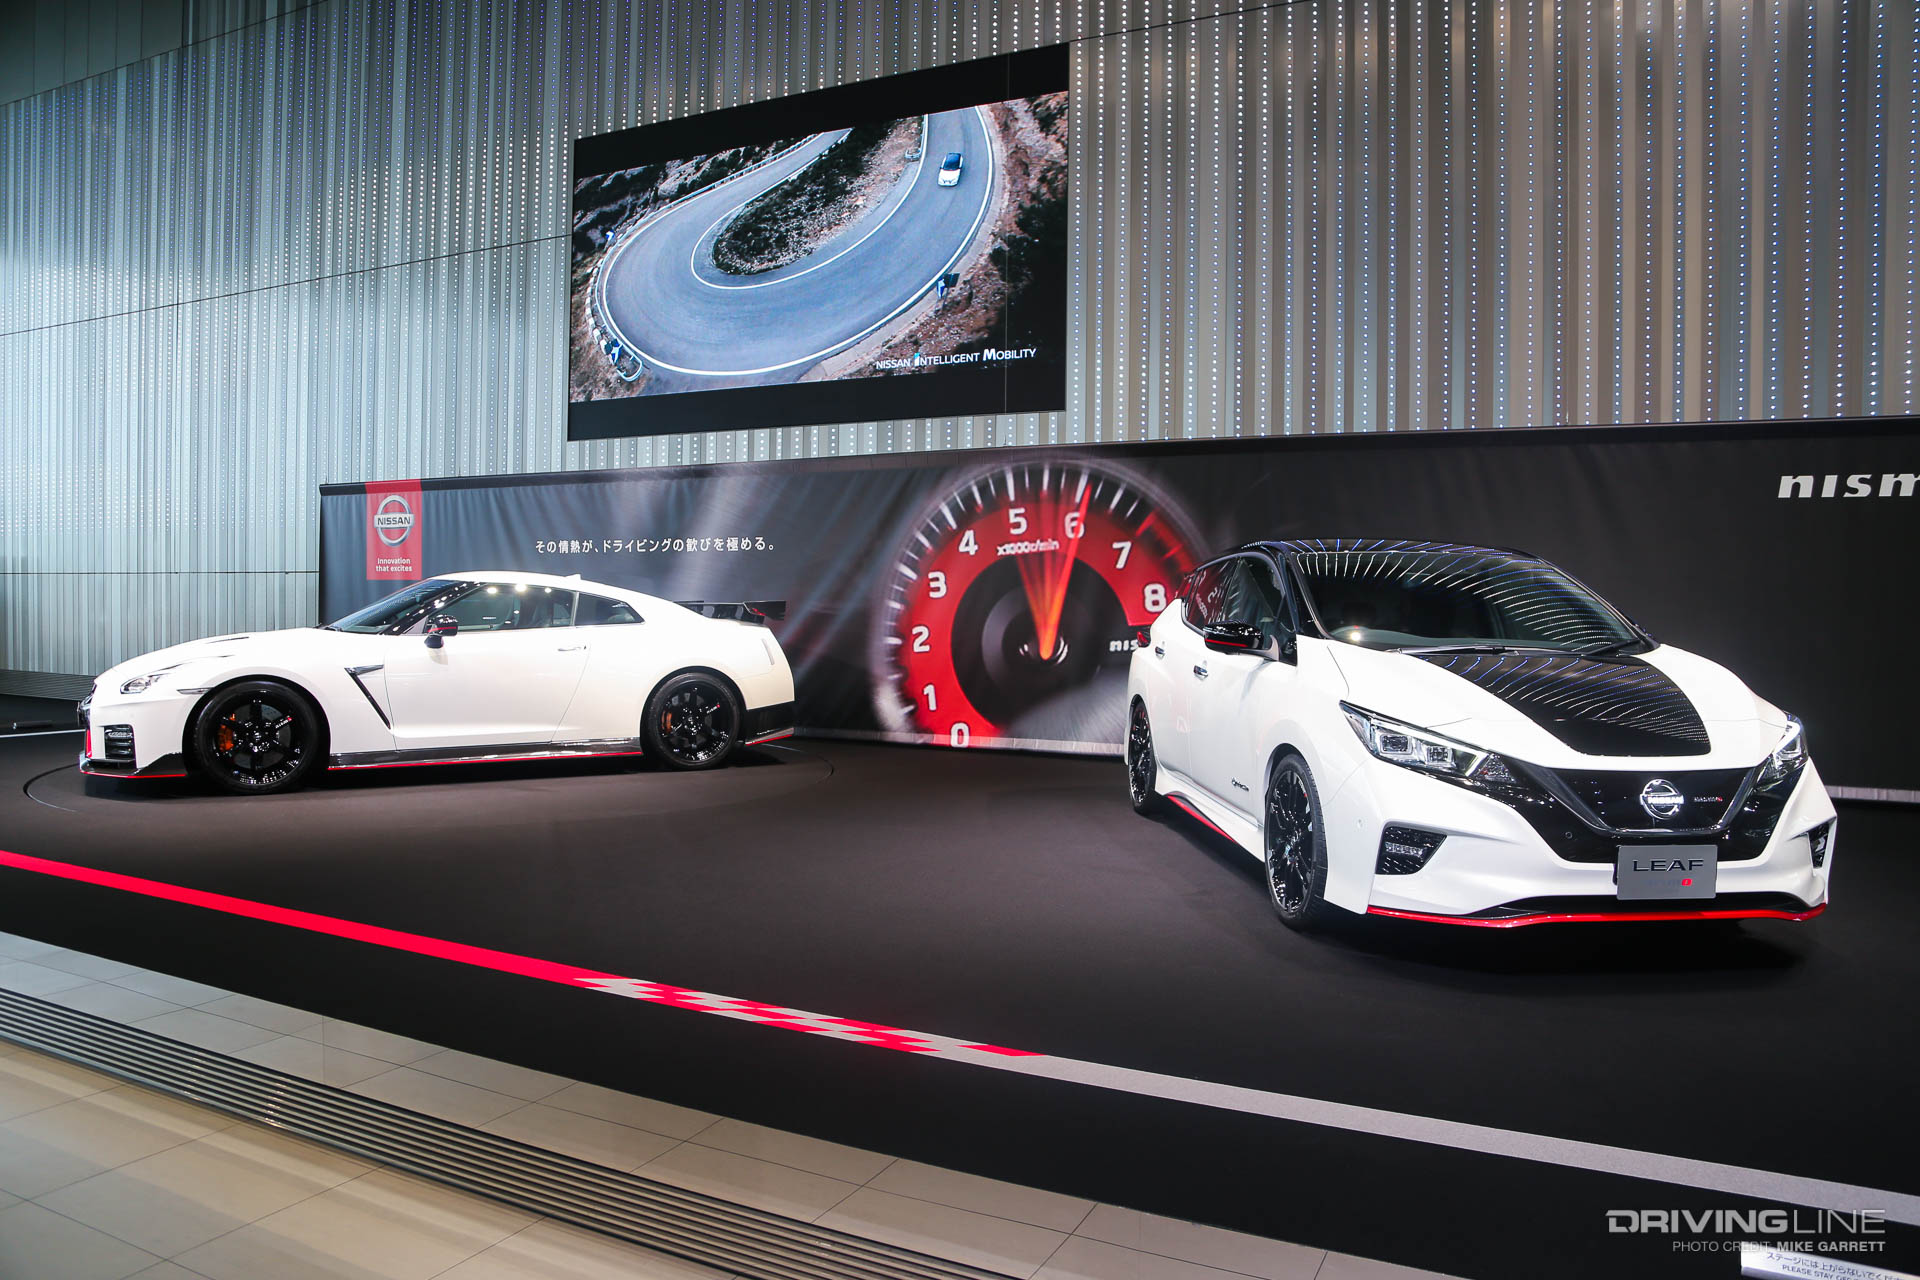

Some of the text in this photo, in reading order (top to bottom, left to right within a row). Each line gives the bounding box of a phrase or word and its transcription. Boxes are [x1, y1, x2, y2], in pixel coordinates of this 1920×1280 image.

[875, 348, 1037, 370] NISSAN INTELLIGENT MOBILITY
[377, 516, 411, 526] NISSAN
[1008, 507, 1027, 535] 5
[1064, 511, 1085, 539] 6
[958, 529, 979, 556] 4
[1112, 541, 1132, 569] 7
[377, 557, 411, 565] Innovation
[927, 571, 947, 599] 3
[1144, 583, 1167, 613] 8
[912, 625, 930, 653] 2
[923, 684, 937, 711] 1
[950, 722, 970, 748] 0
[1633, 858, 1704, 872] LEAF
[1782, 1264, 1812, 1276] PLEASE
[1814, 1270, 1834, 1280] STAY
